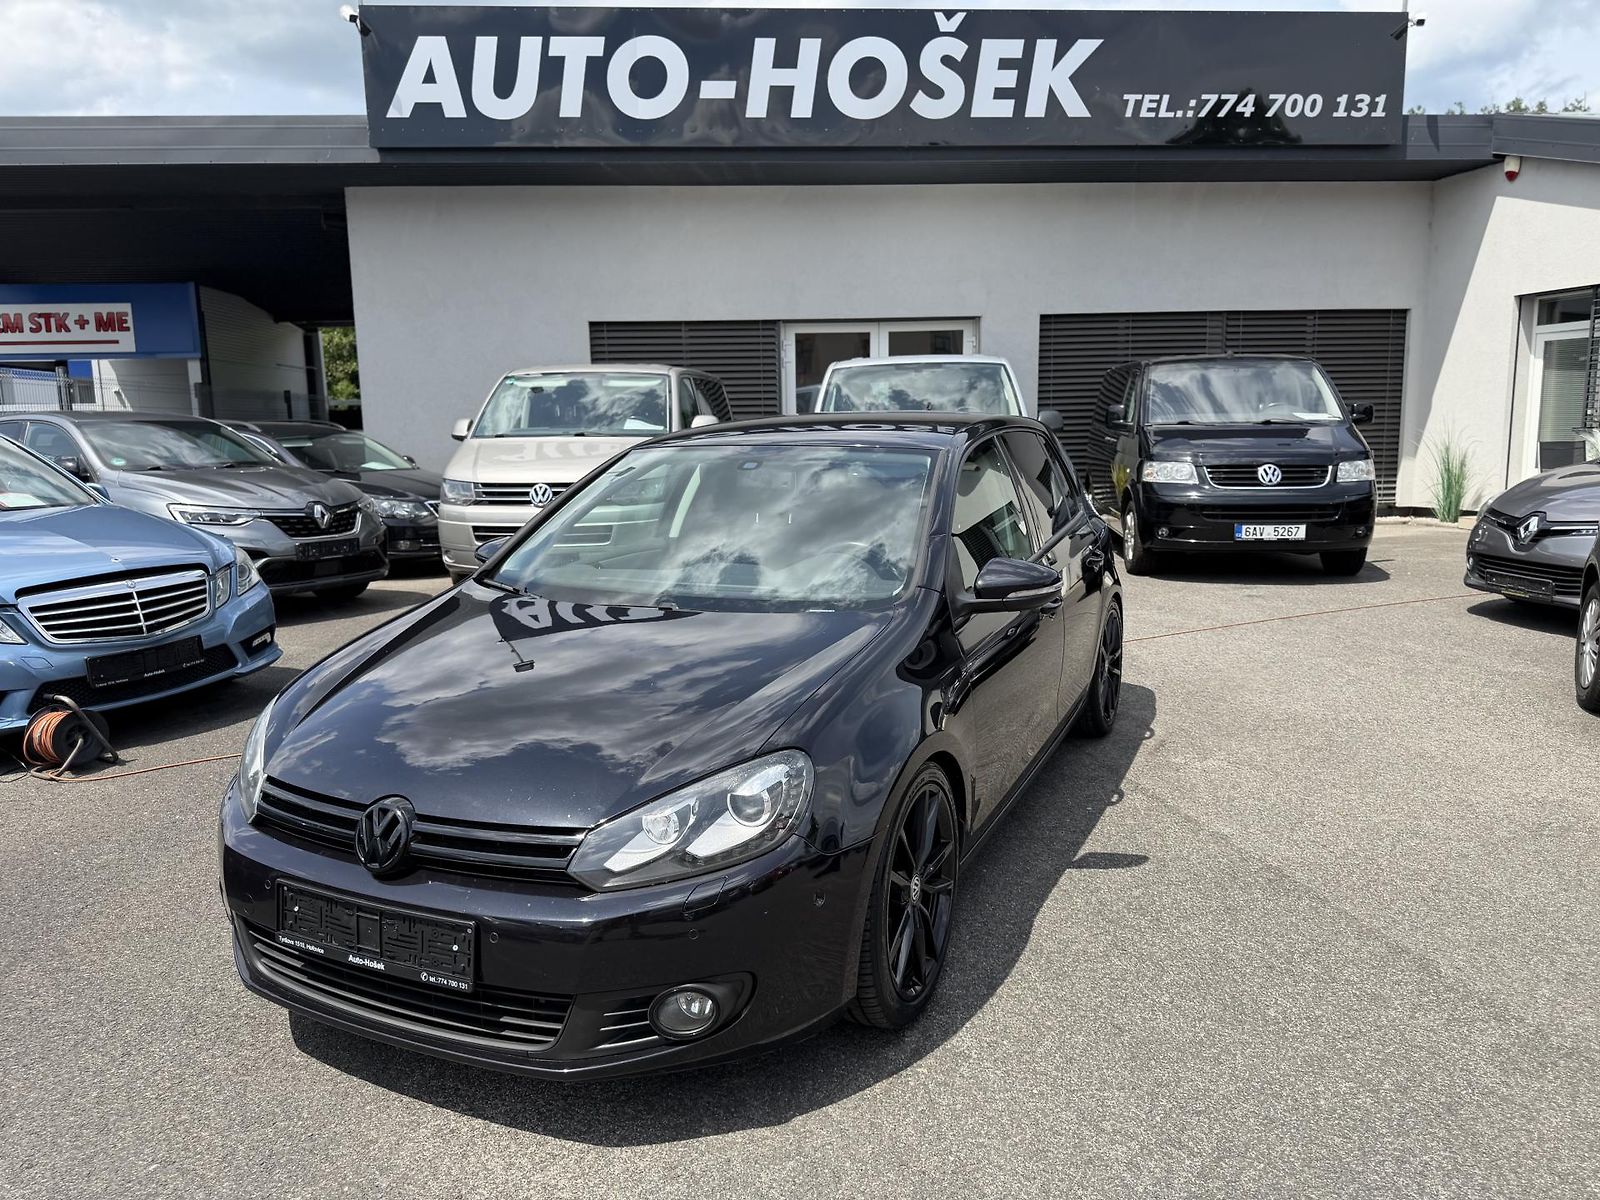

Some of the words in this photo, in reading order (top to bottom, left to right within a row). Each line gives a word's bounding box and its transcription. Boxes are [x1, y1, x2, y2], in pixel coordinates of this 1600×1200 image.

[386, 11, 1104, 120] AUTO-HOŠEK
[1123, 93, 1255, 118] TEL.:774
[1265, 93, 1323, 118] 700
[1332, 93, 1387, 118] 131
[0, 312, 24, 333] M
[28, 312, 71, 333] STK
[94, 311, 131, 332] ME
[1244, 526, 1265, 537] 6AV
[1273, 526, 1300, 537] 5267
